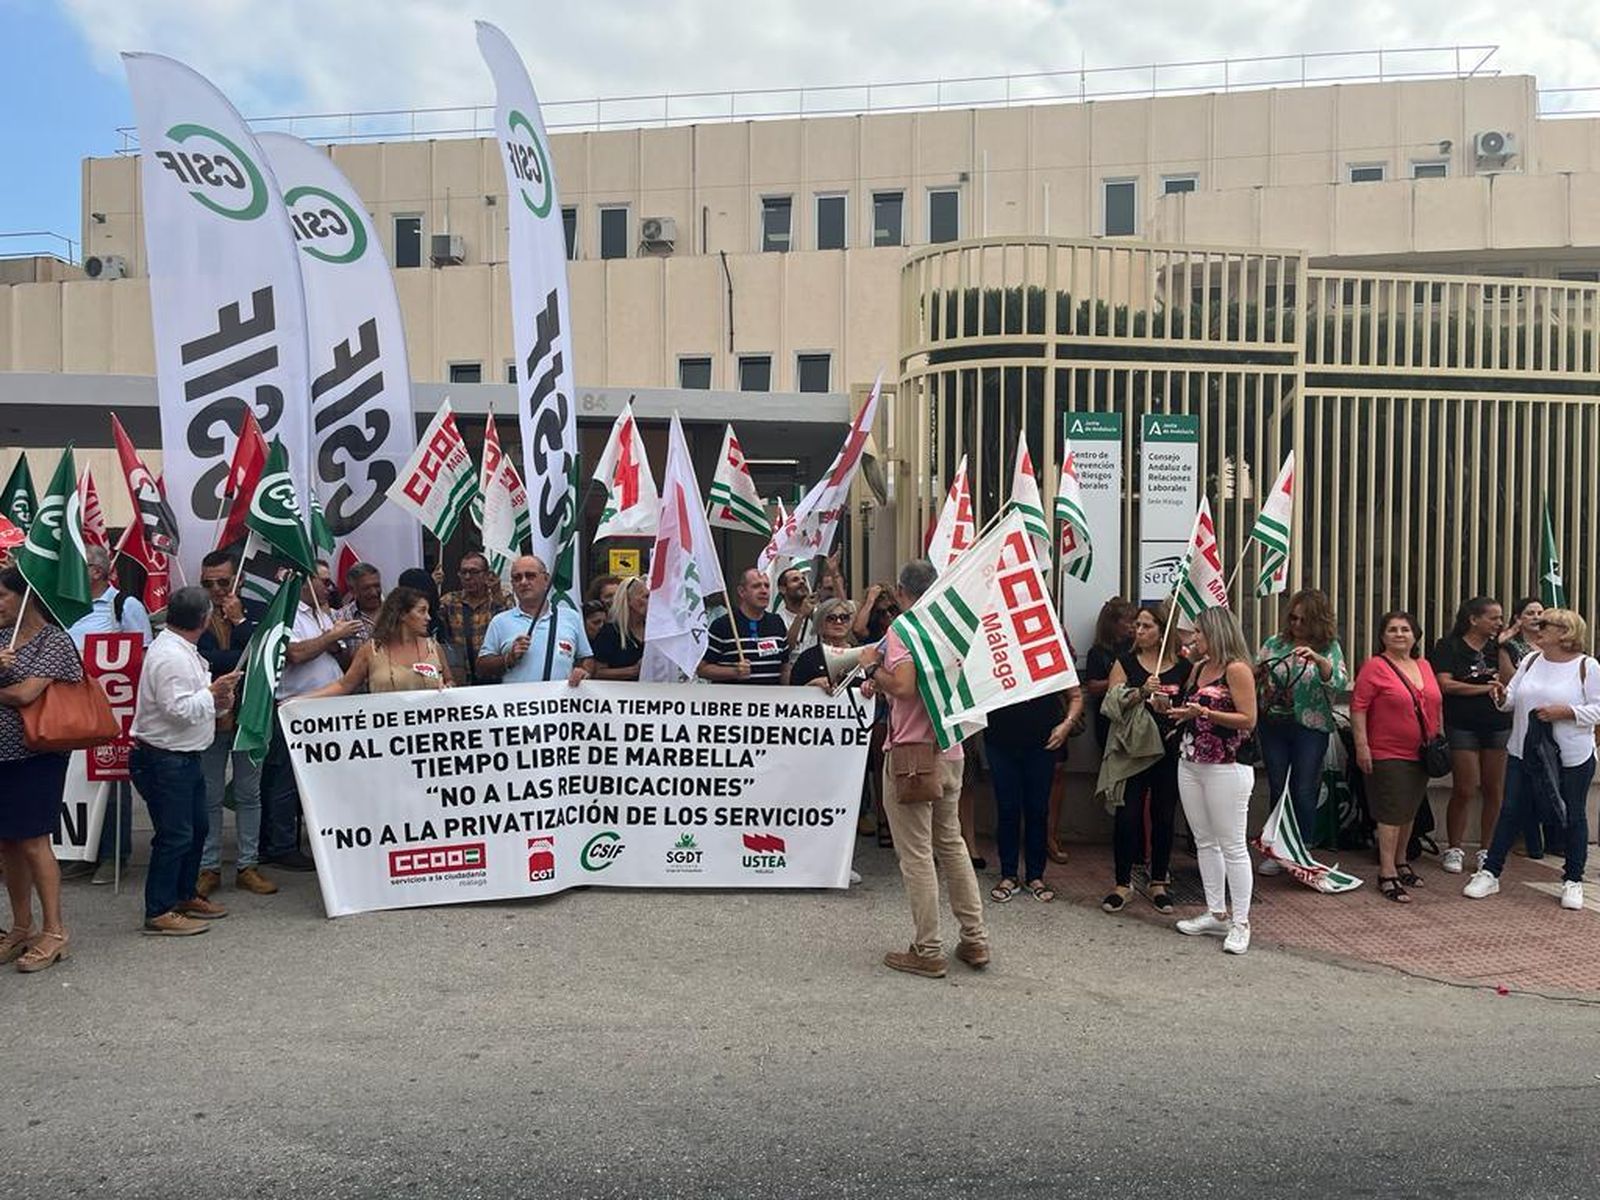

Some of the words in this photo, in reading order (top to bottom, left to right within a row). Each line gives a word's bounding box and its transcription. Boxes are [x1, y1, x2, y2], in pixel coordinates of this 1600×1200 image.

[1099, 451, 1108, 459] de
[1148, 452, 1181, 462] Consejo
[1148, 463, 1180, 471] Andaluz
[1182, 463, 1192, 471] de
[1081, 471, 1112, 481] Riesgos
[1148, 473, 1191, 482] Relaciones
[1079, 482, 1109, 490] borales
[1148, 484, 1187, 492] Laborales
[981, 612, 1017, 690] Málaga
[96, 640, 134, 738] UGT
[290, 709, 367, 735] COMITÉ
[372, 712, 399, 729] DE
[404, 704, 498, 726] EMPRESA
[503, 698, 612, 718] RESIDENCIA
[617, 699, 686, 716] TIEMPO
[690, 701, 743, 717] LIBRE
[747, 703, 770, 718] DE
[775, 704, 868, 720] MARBELLA
[348, 738, 383, 761] AL
[389, 729, 483, 756] CIERRE
[489, 722, 617, 748] TEMPORAL
[624, 723, 654, 743] DE
[661, 724, 691, 743] LA
[697, 725, 835, 746] RESIDENCIA
[840, 727, 869, 746] DE
[411, 751, 509, 779] TIEMPO
[516, 745, 581, 770] LIBRE
[587, 745, 619, 766] DE
[483, 783, 502, 804] A
[507, 778, 554, 801] LAS
[379, 824, 398, 846] A
[404, 820, 438, 842] LA
[445, 799, 619, 838] PRIVATIZACIÓN
[626, 806, 657, 826] DE
[663, 806, 708, 826] LOS
[589, 842, 626, 860] CSIF
[666, 851, 704, 864] SGDT
[395, 850, 463, 872] CCOO
[742, 855, 787, 868] USTEA
[531, 868, 554, 881] CGT
[391, 877, 427, 886] servicios
